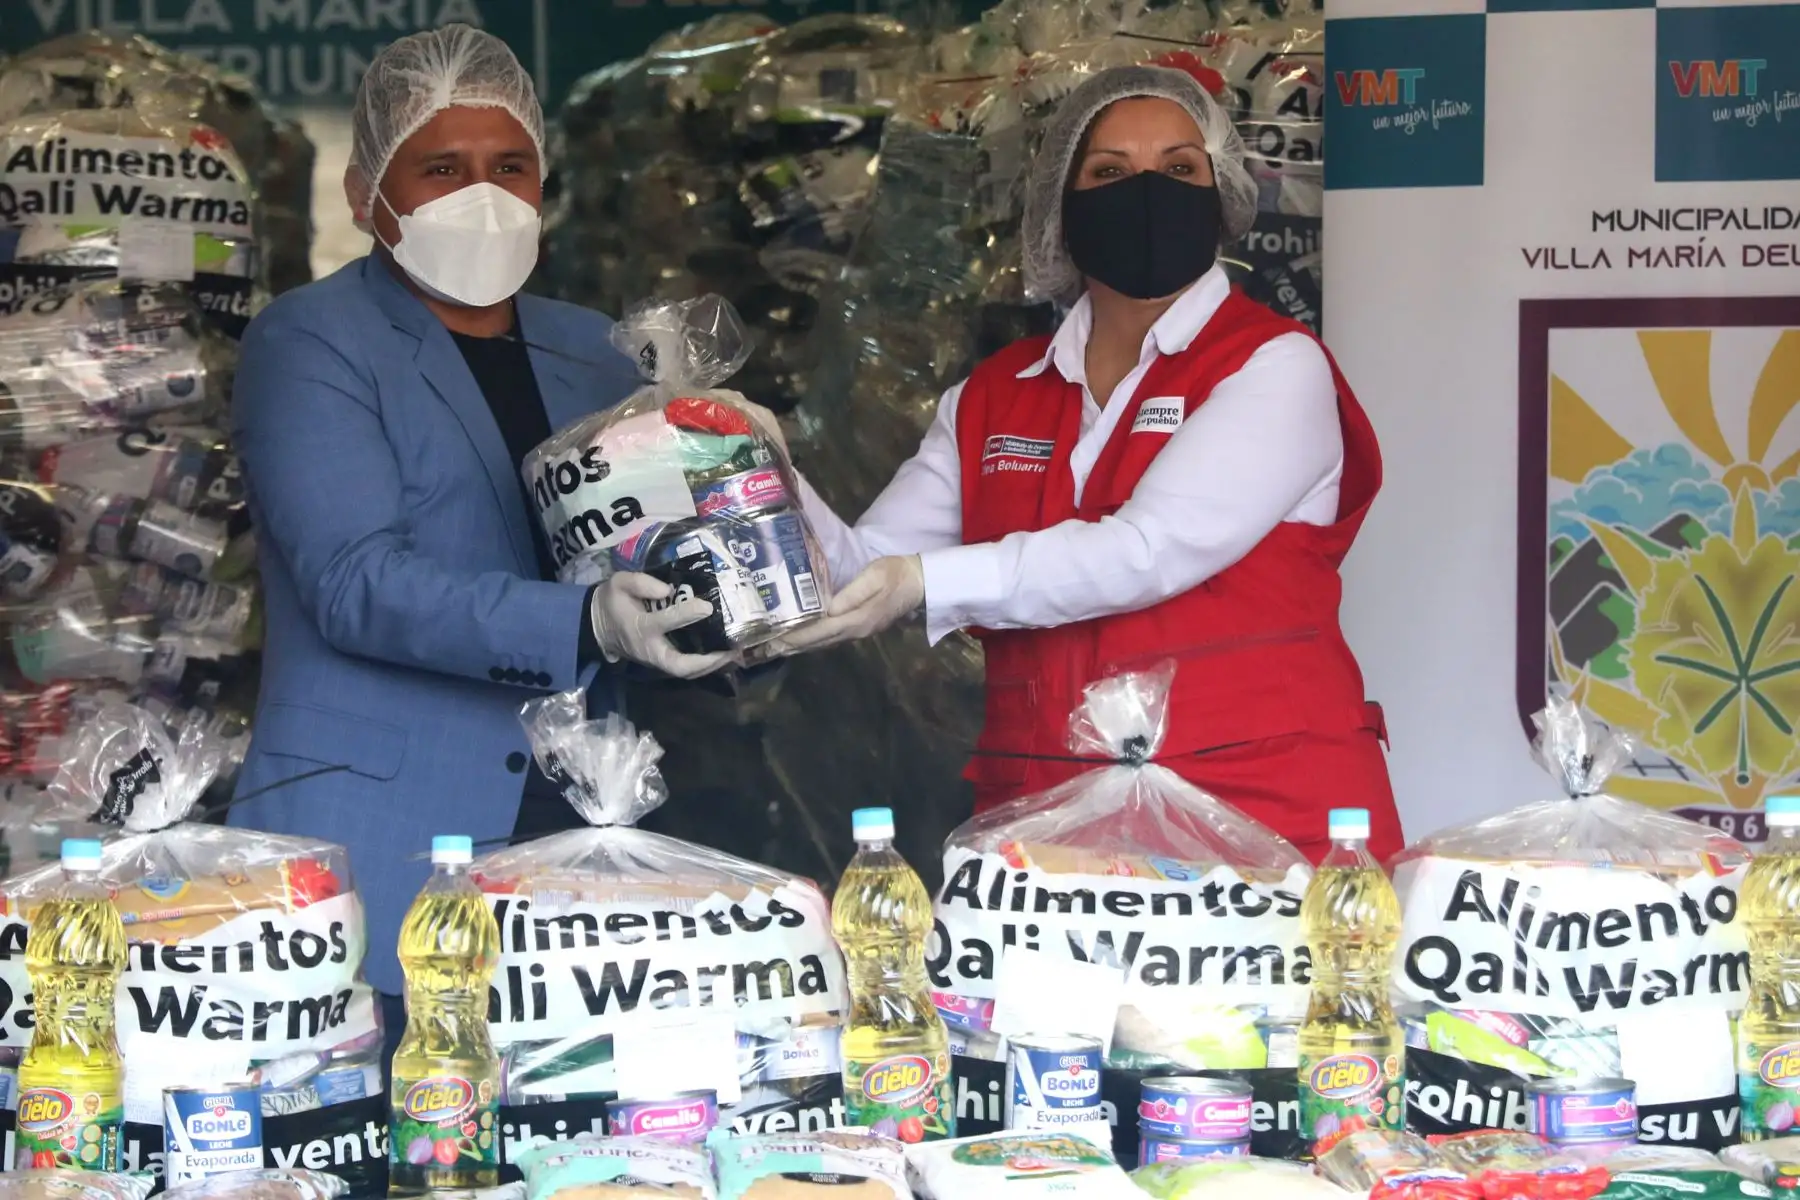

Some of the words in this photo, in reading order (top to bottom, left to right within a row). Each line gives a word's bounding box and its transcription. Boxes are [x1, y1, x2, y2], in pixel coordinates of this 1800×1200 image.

[1334, 68, 1426, 107] VMT
[1668, 58, 1768, 98] VMT
[1393, 105, 1430, 136] mejor
[1734, 96, 1772, 128] mejor
[92, 184, 249, 226] Warma
[1521, 247, 1613, 270] VILLA
[1627, 236, 1727, 269] MARÍA
[1146, 416, 1179, 427] pueblo
[997, 459, 1046, 473] Boluarte
[941, 858, 1303, 918] Alimentos
[1404, 935, 1550, 1004] Qali
[570, 958, 829, 1017] Warma
[128, 985, 353, 1042] Warma
[869, 1065, 922, 1097] Cielo
[1317, 1064, 1369, 1092] Cielo
[19, 1097, 63, 1123] Cielo
[410, 1085, 463, 1114] Cielo
[1062, 1099, 1085, 1107] LECHE
[1036, 1109, 1100, 1126] Evaporada
[1638, 1112, 1698, 1141] su
[185, 1151, 256, 1169] Evaporada
